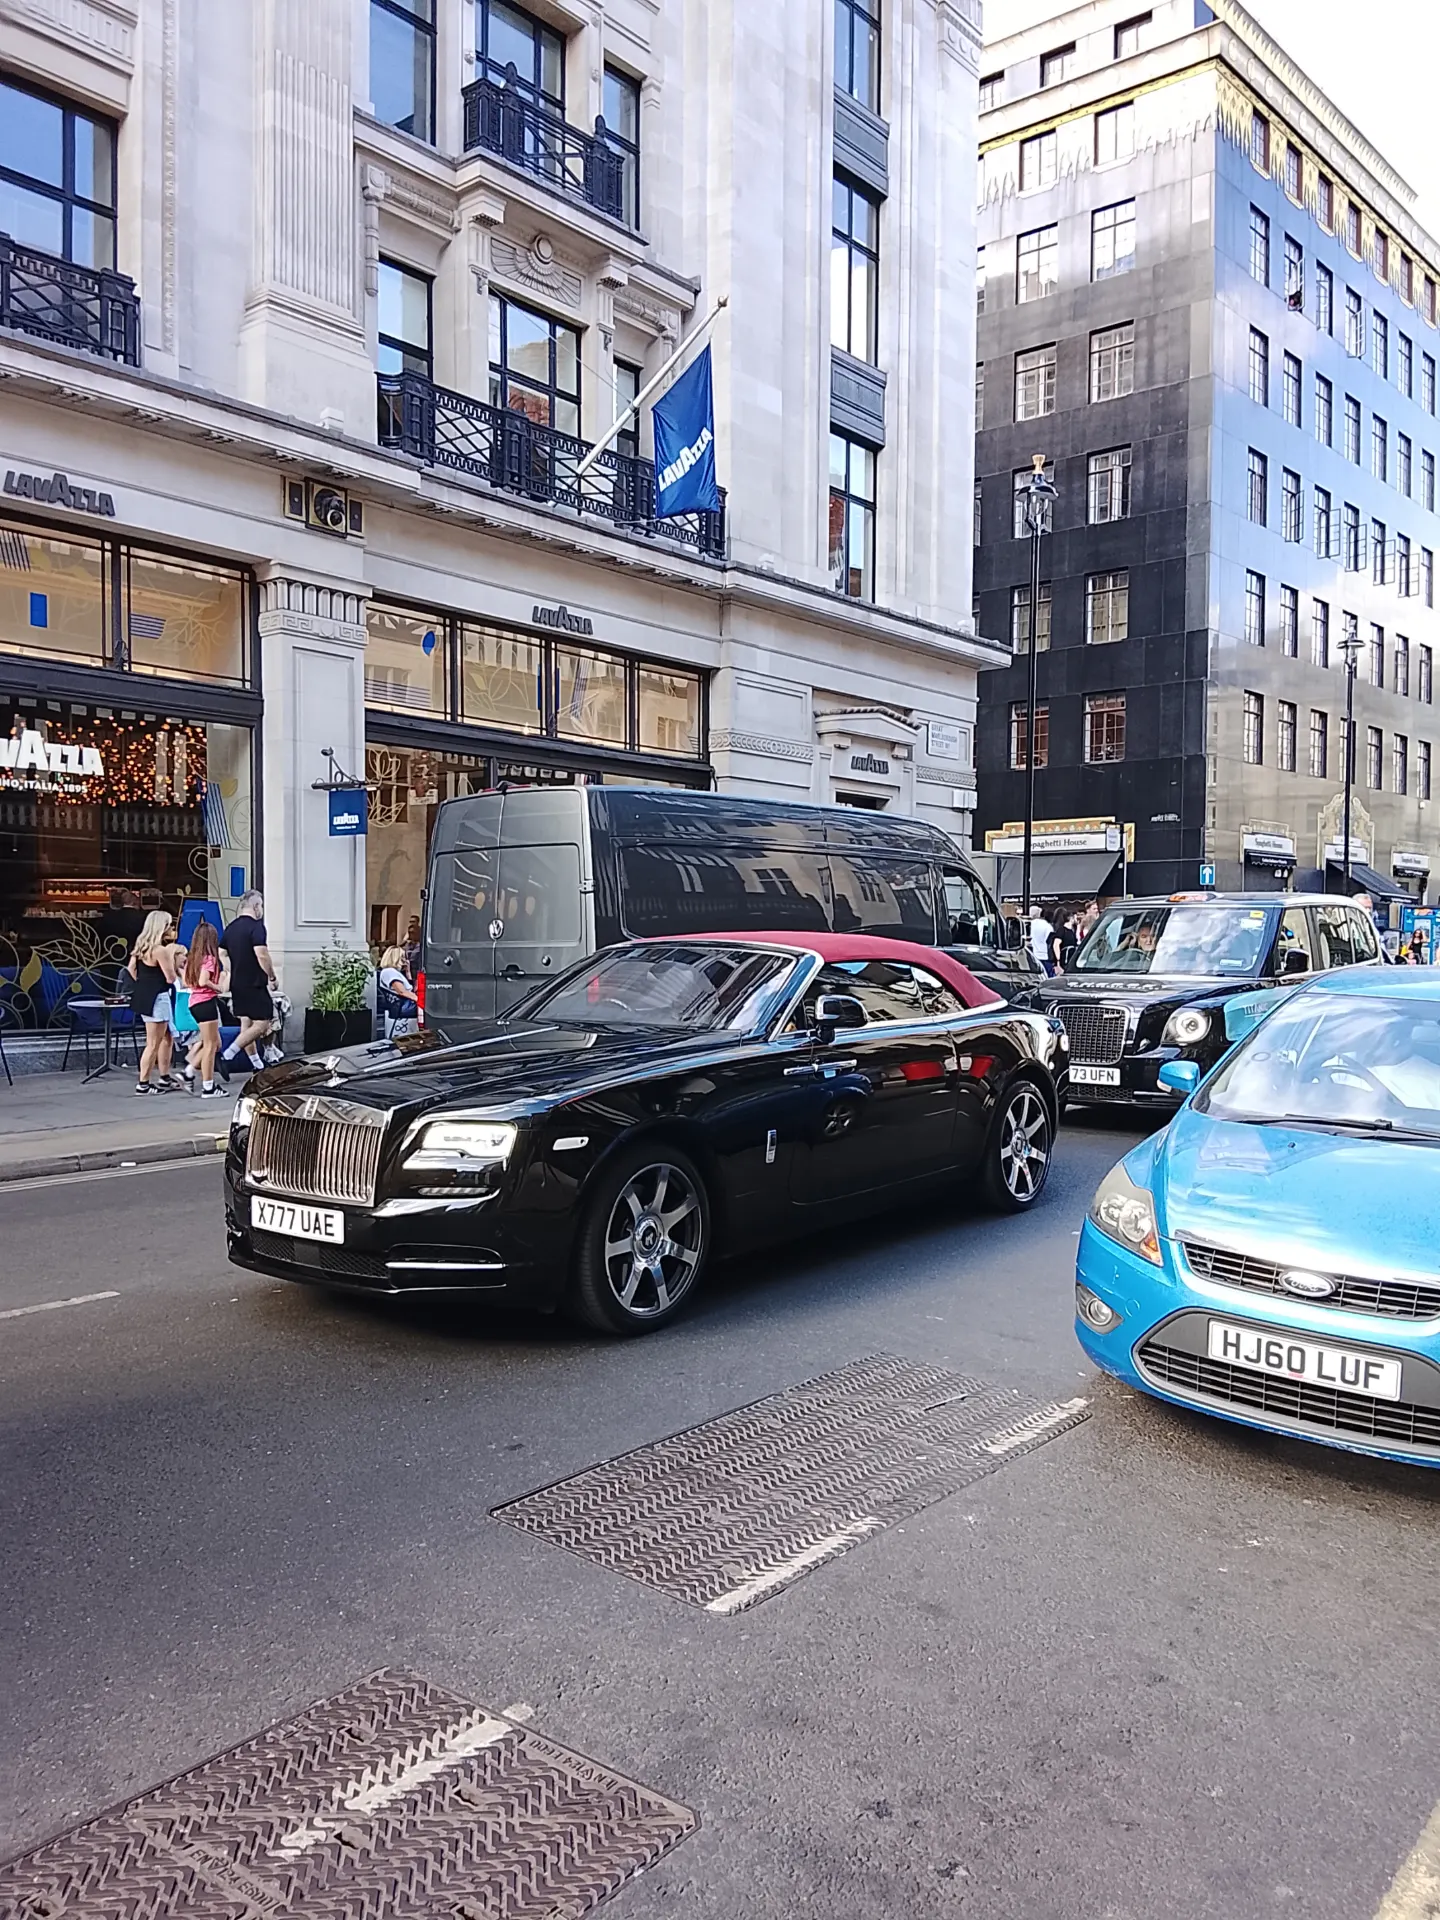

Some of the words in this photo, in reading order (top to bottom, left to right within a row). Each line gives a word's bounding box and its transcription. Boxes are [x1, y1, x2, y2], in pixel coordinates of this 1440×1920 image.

[658, 426, 713, 492] LAVAZZA
[3, 470, 116, 517] LAVAZZA
[532, 605, 594, 636] LAVAZZA
[851, 753, 889, 774] LAVAZZA
[1031, 839, 1061, 850] paghetti
[1064, 839, 1087, 847] House
[1090, 1069, 1115, 1083] UFN
[258, 1201, 296, 1230] X777
[301, 1210, 335, 1237] UAE
[1222, 1330, 1306, 1374] HJ60
[1317, 1351, 1385, 1389] LUF
